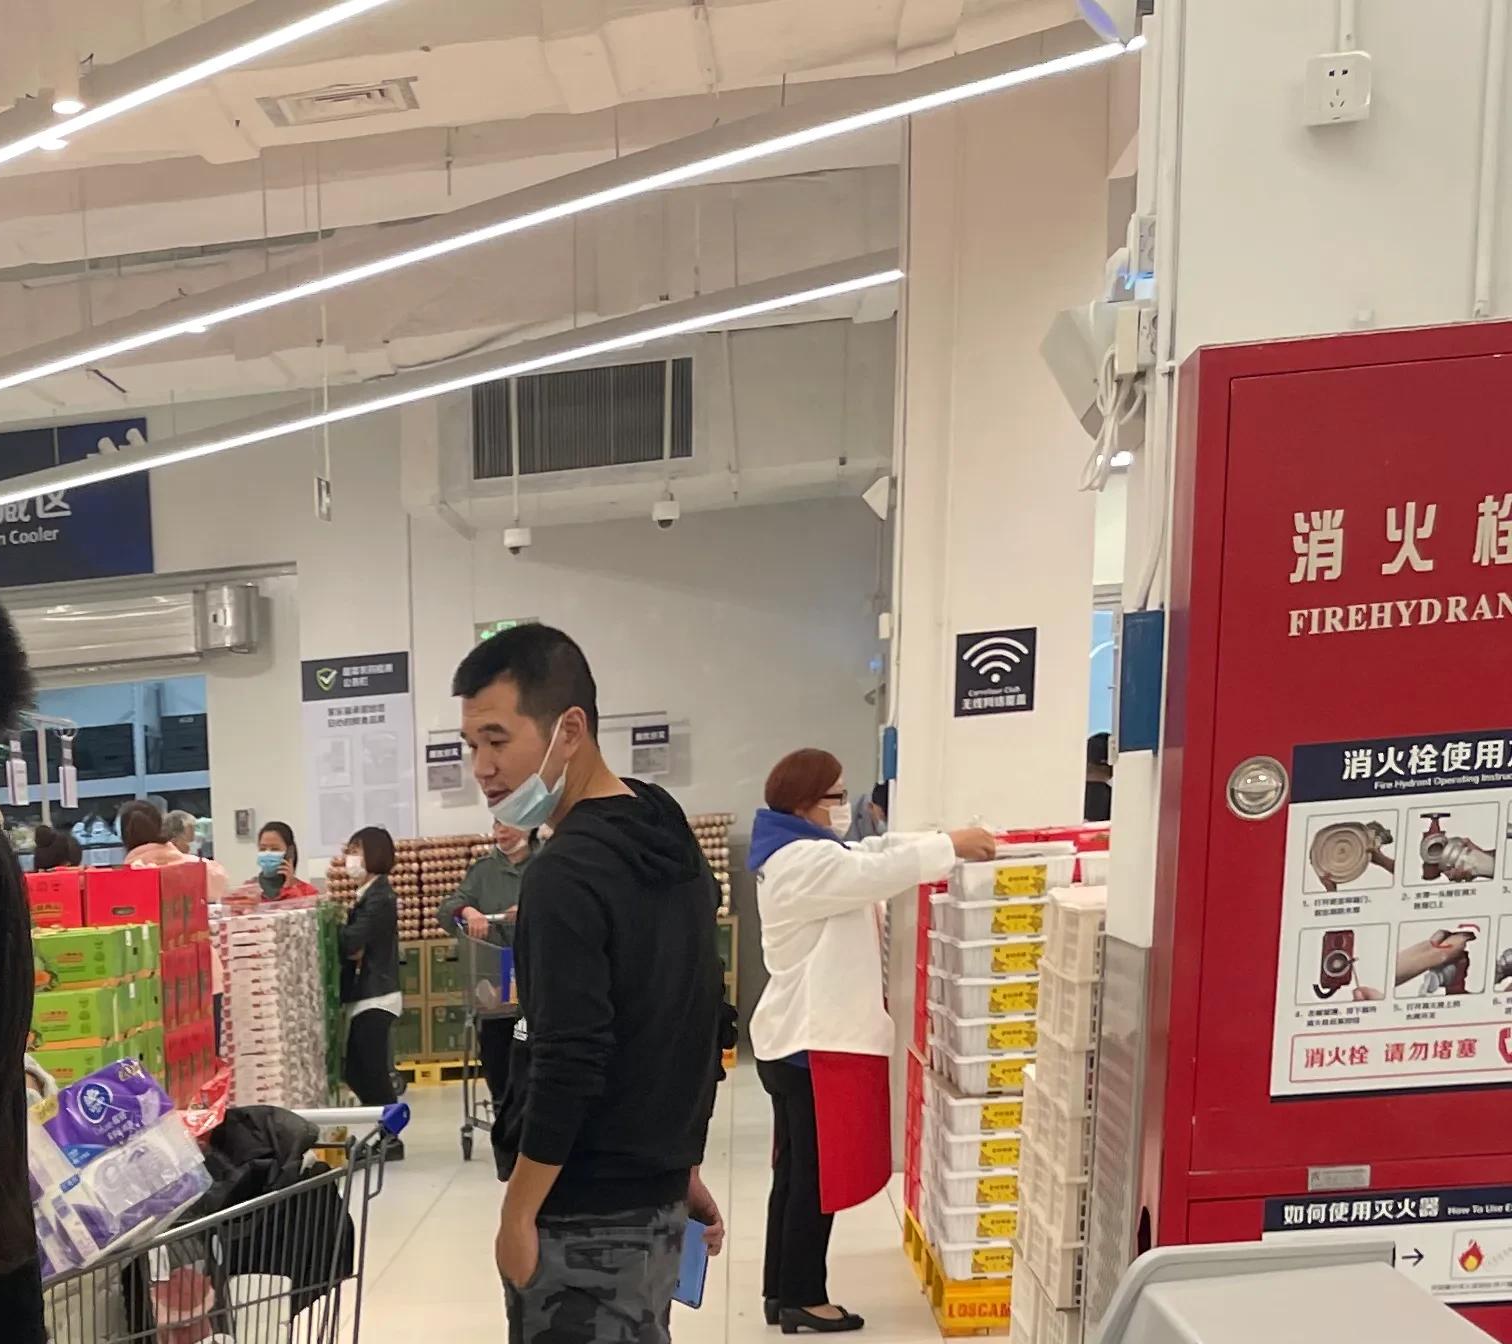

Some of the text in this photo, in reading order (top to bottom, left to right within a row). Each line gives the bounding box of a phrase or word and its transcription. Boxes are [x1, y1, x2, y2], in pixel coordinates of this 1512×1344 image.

[9, 528, 59, 545] Cooler
[1289, 494, 1512, 583] 消火栓
[1342, 739, 1512, 780] 消火栓使用
[1304, 1038, 1478, 1069] 消火栓 请勿堵塞
[1283, 1197, 1439, 1225] 如何使用灭火器
